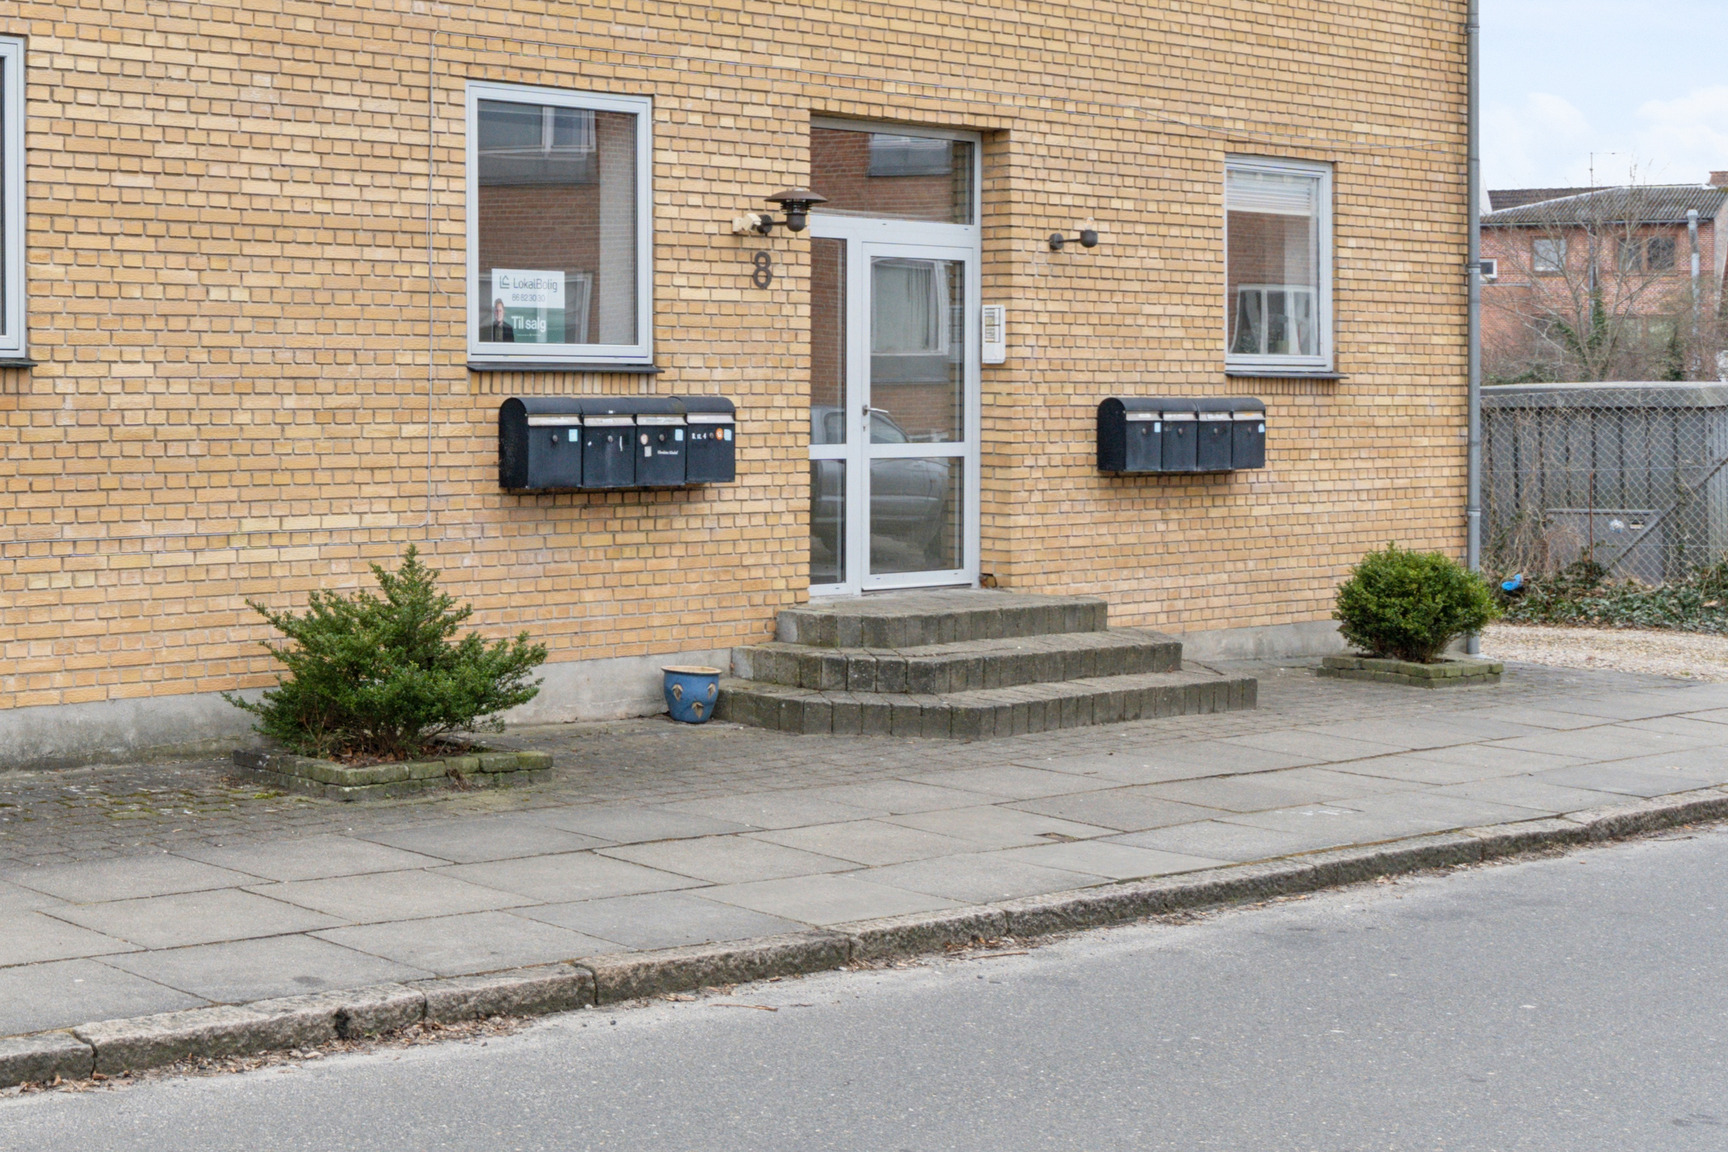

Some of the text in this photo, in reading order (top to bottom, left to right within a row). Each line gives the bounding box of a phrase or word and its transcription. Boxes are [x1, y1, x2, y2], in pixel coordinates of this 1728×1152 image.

[752, 251, 772, 290] 8
[513, 277, 558, 293] LokalBolig
[529, 294, 537, 302] 30
[511, 315, 547, 333] Til salg
